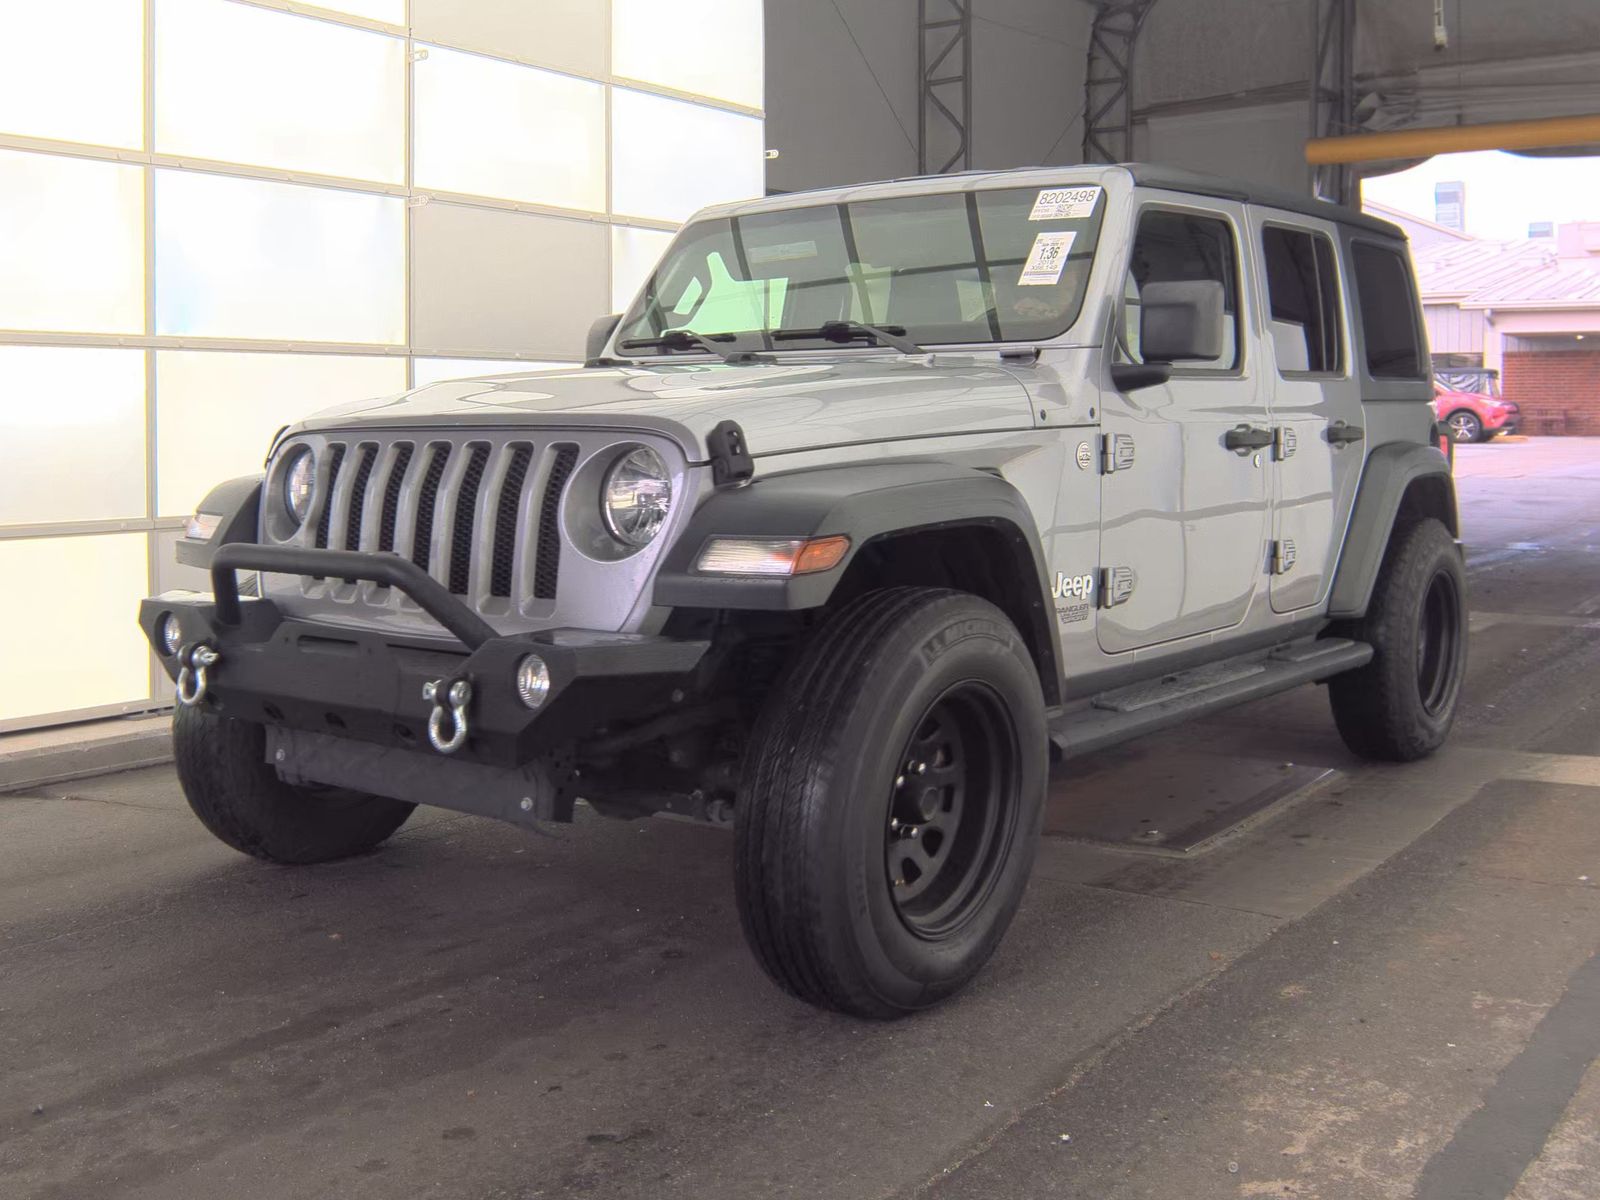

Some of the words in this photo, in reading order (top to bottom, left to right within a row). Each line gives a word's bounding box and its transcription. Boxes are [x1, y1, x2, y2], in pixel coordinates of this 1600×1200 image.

[1040, 190, 1096, 205] 8202498
[1040, 246, 1060, 260] 1:36
[1051, 572, 1093, 600] Jeep
